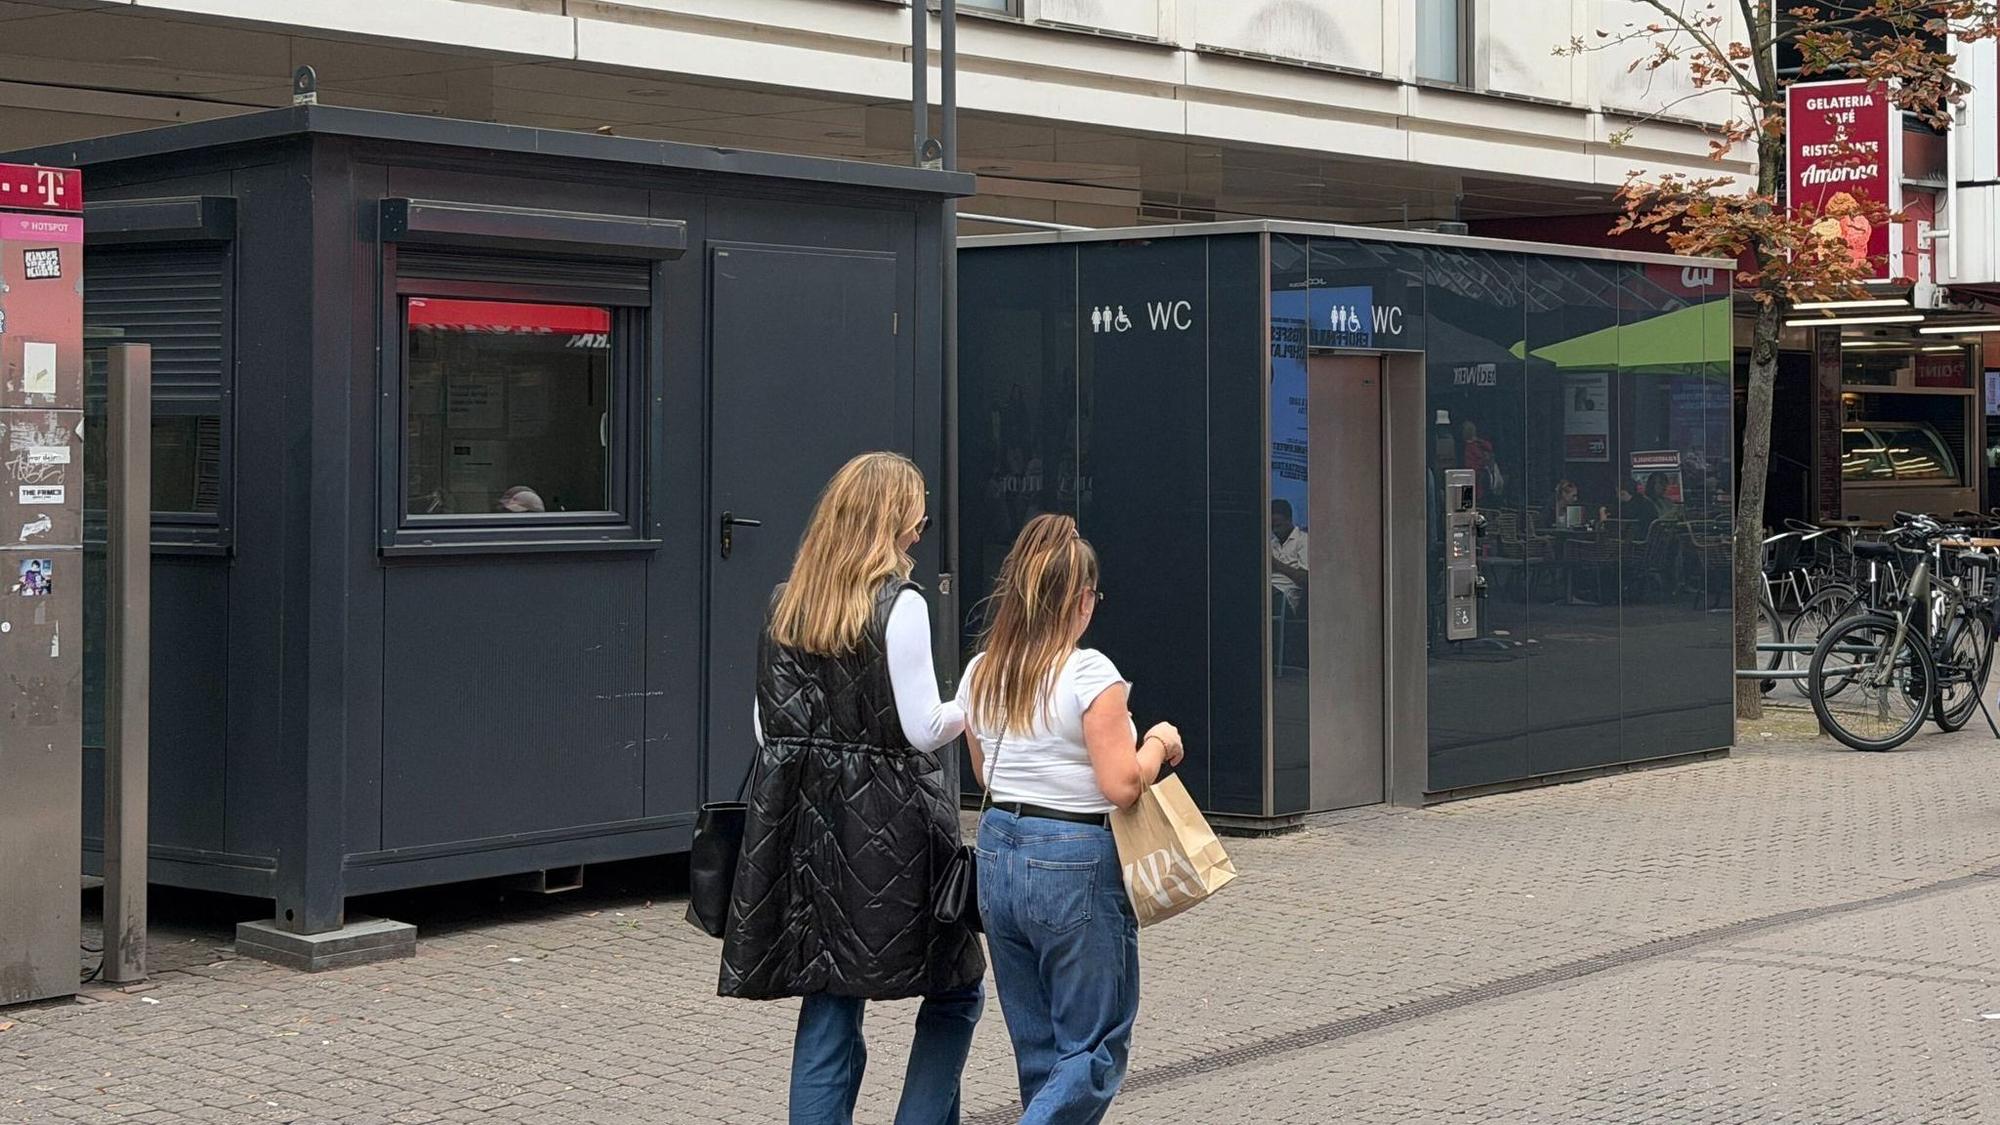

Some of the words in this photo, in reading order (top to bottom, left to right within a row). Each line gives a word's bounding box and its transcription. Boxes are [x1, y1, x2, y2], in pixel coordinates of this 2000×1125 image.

[1807, 95, 1873, 110] GELATERIA
[1802, 142, 1878, 157] RISTOANTE
[38, 171, 64, 206] T
[31, 222, 69, 232] HOTSPOT
[1147, 300, 1192, 331] WC
[1371, 305, 1402, 335] WC
